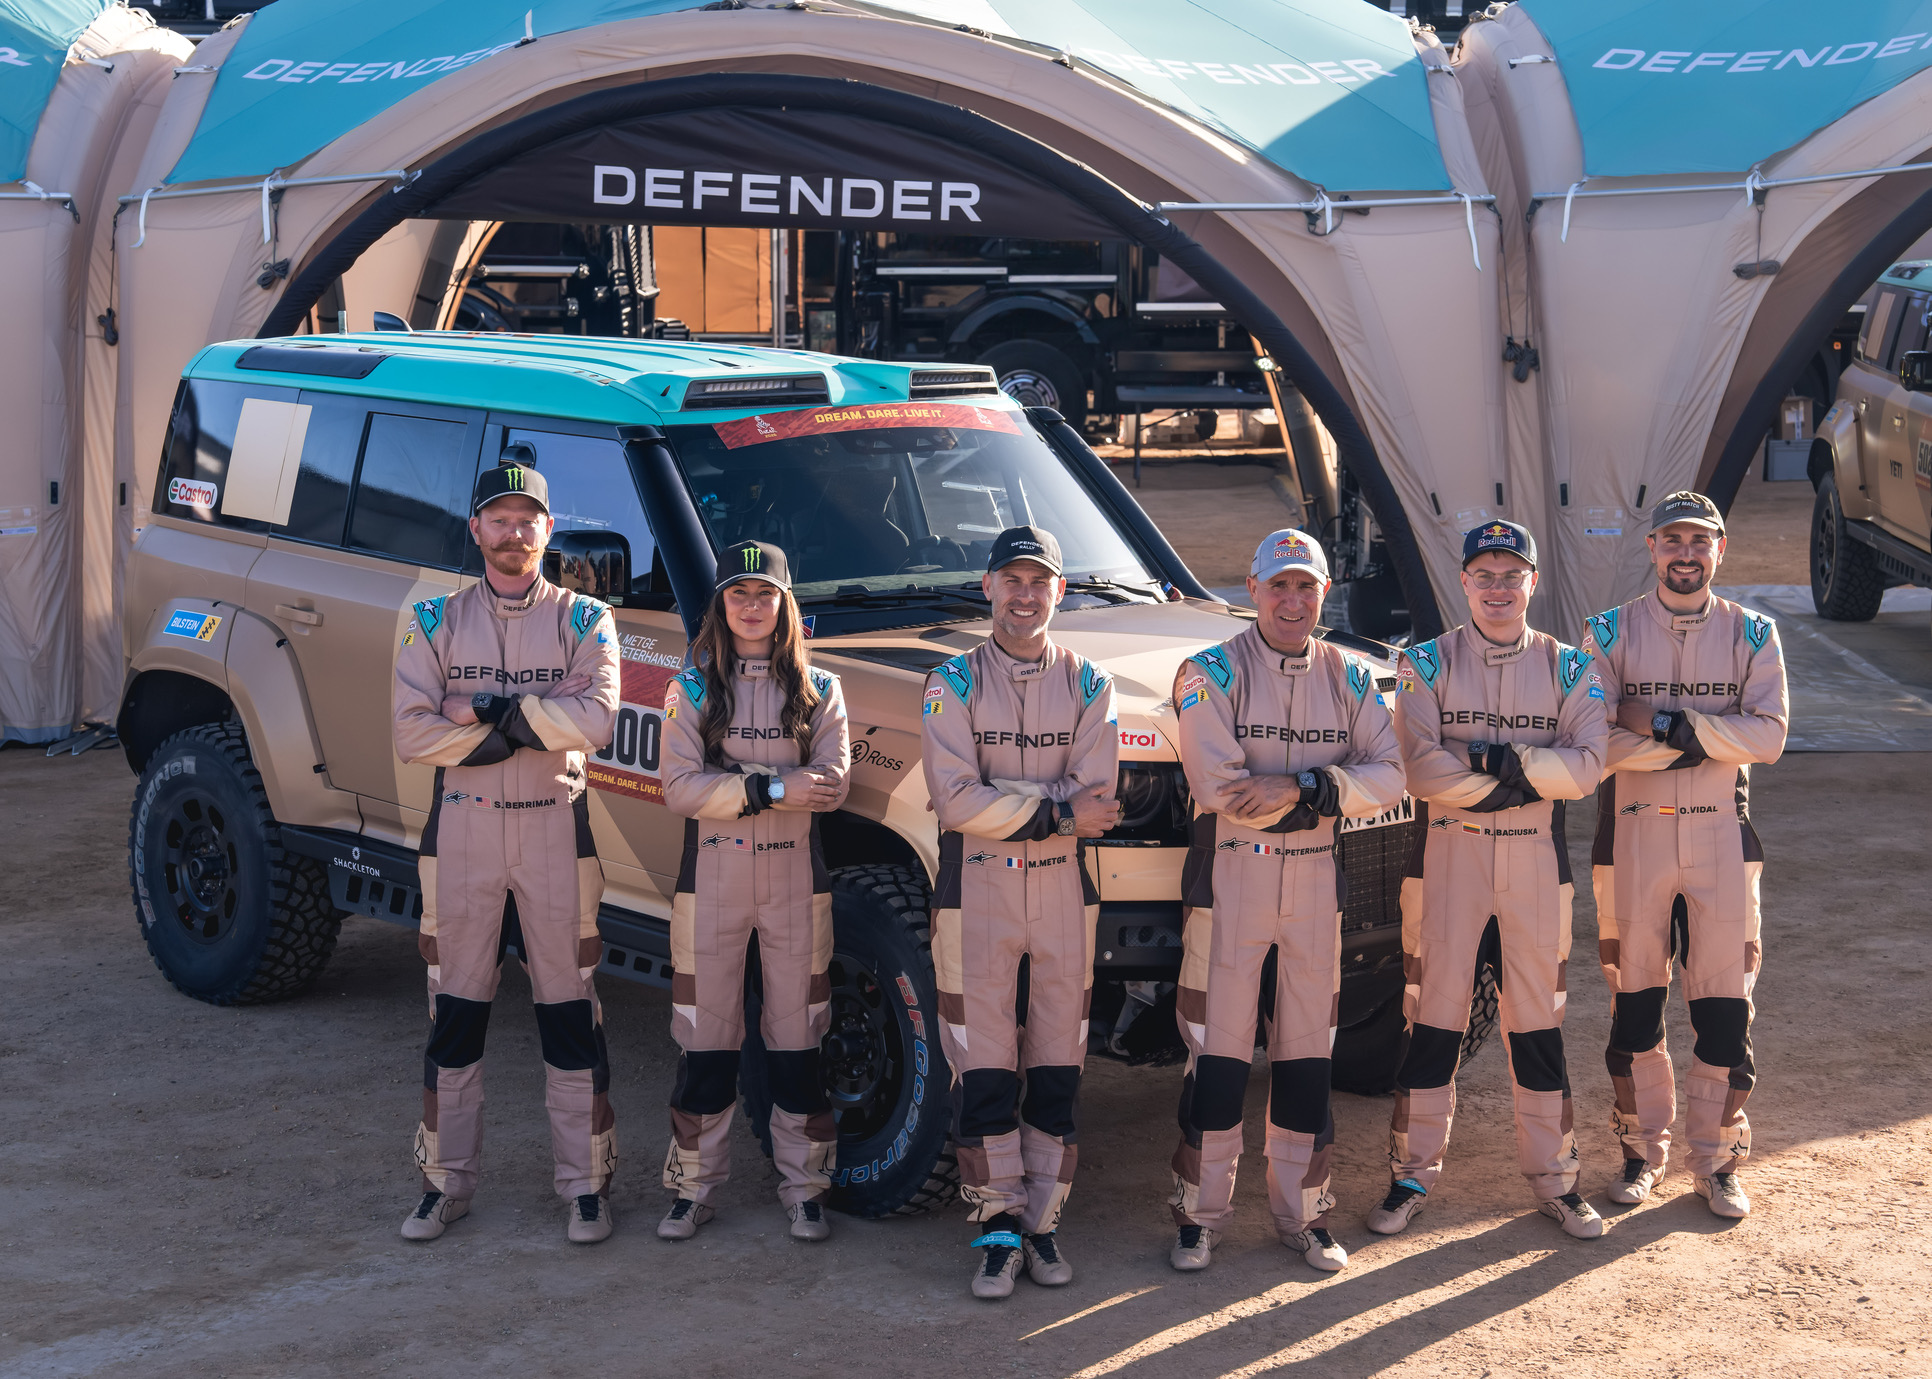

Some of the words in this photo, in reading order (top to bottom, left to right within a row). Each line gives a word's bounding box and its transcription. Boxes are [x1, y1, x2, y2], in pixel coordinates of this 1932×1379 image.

[1592, 32, 1932, 73] DEFENDE
[242, 39, 523, 84] DEFENDER
[1079, 47, 1398, 85] DEFENDER
[593, 164, 982, 222] DEFENDER
[814, 411, 866, 424] DREAM.
[866, 409, 904, 419] DARE.
[904, 408, 931, 418] LIVE
[931, 409, 946, 418] IT.
[1889, 459, 1903, 480] YETI
[178, 483, 216, 506] Castrol
[1665, 501, 1682, 511] DUSTY
[1681, 501, 1700, 509] MATCH
[1010, 540, 1045, 549] DEFENDER
[1477, 536, 1497, 548] Red
[1497, 536, 1517, 547] Bull
[1273, 548, 1294, 559] Red
[1293, 548, 1312, 561] Bull
[170, 616, 201, 631] BILSTEIN
[622, 633, 658, 650] METGE
[449, 665, 565, 685] DEFENDER
[1625, 682, 1739, 698] DEFENDER
[1441, 709, 1557, 732] DEFENDER
[974, 730, 1076, 749] DEFENDE
[1118, 731, 1156, 747] trol
[1235, 724, 1348, 744] DEFENDER
[866, 750, 904, 771] Ross
[588, 770, 617, 785] DREAM.
[617, 778, 639, 790] DARE.
[640, 783, 658, 796] LIVE
[494, 797, 556, 809] S.BERRIMAN
[1679, 805, 1719, 815] O.VIDAL
[1484, 827, 1538, 837] R.BACIUSKA
[757, 840, 796, 852] S.PRICE
[333, 857, 381, 878] SHACKLETON
[1028, 855, 1067, 869] M.METGE
